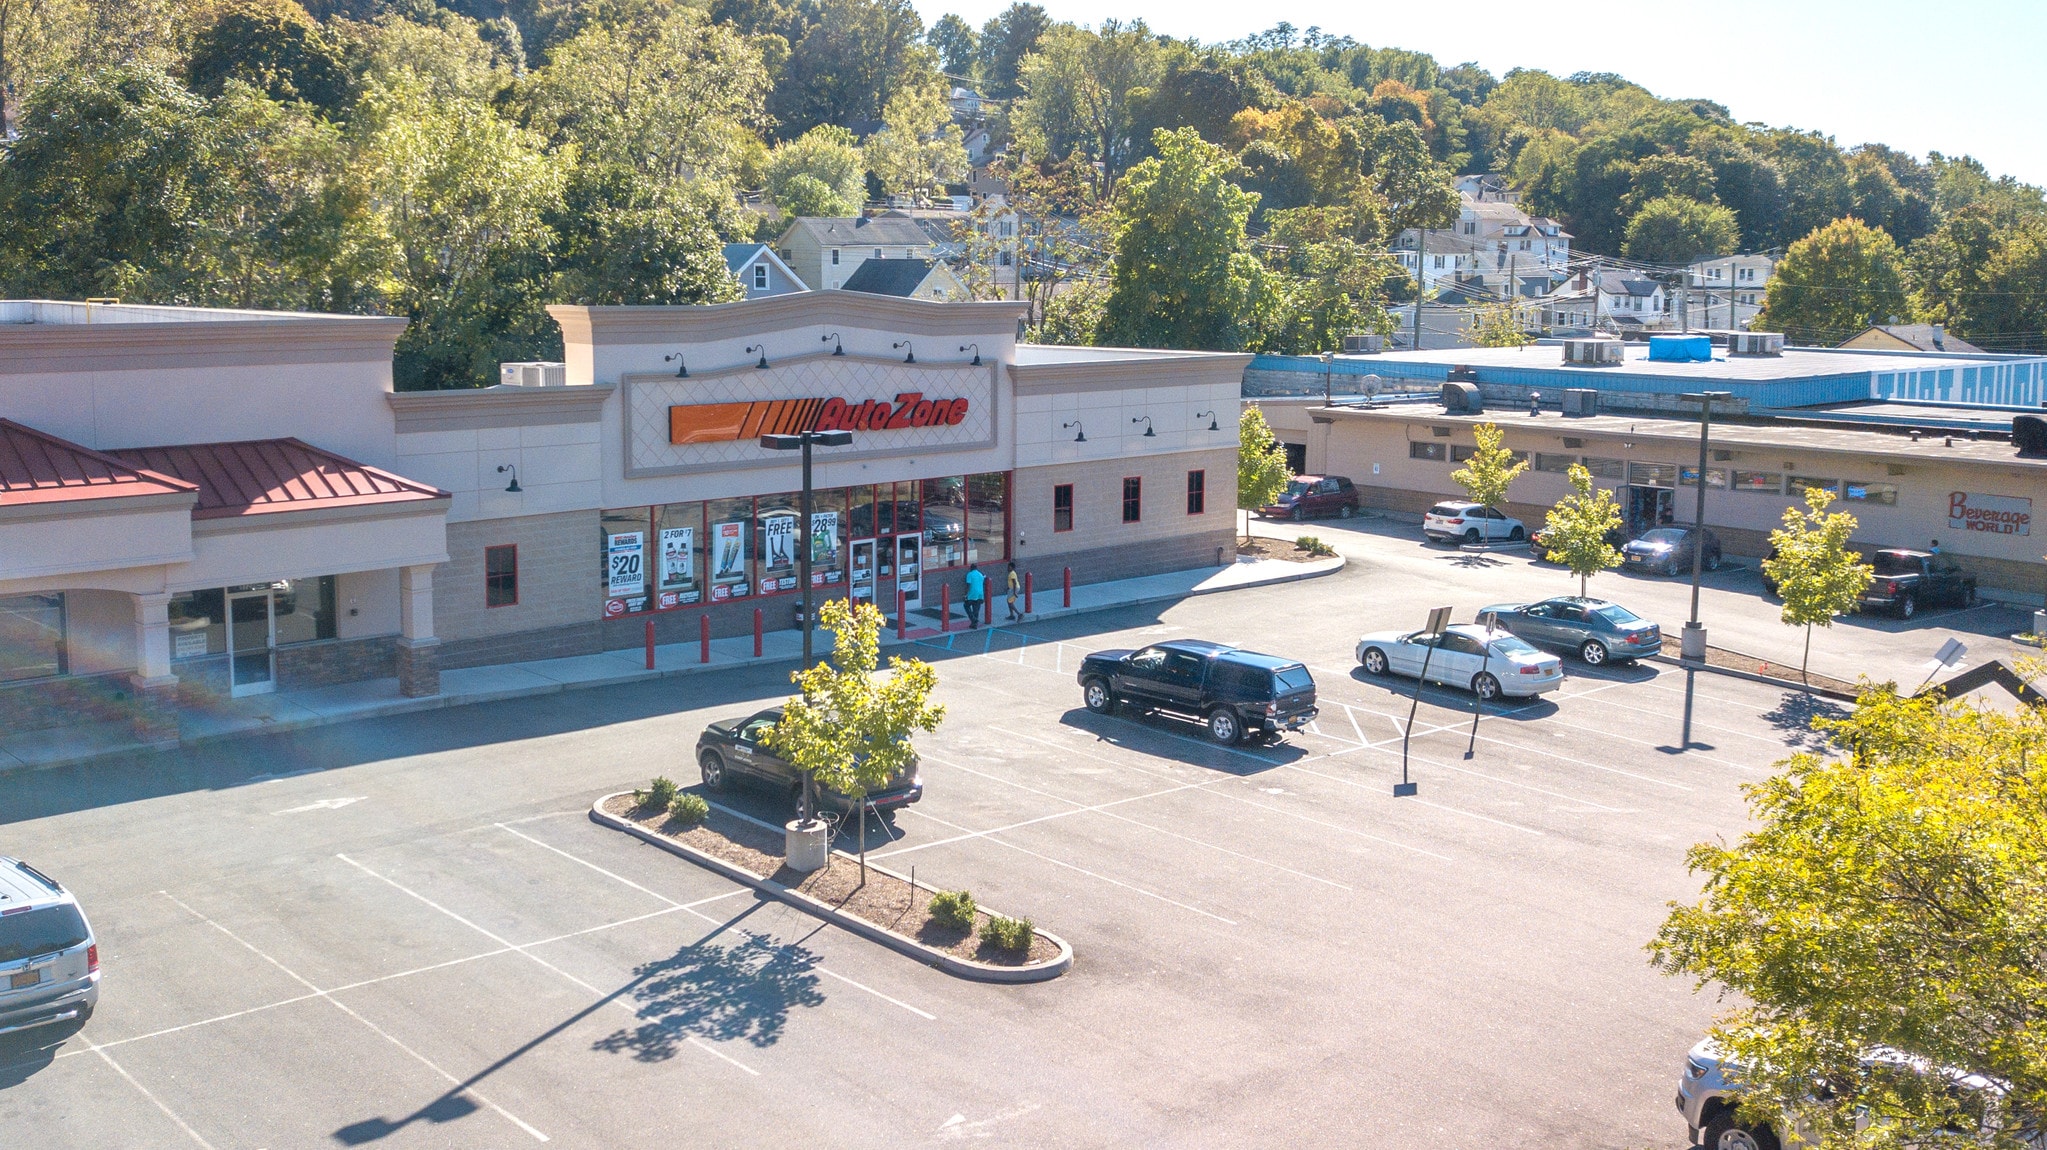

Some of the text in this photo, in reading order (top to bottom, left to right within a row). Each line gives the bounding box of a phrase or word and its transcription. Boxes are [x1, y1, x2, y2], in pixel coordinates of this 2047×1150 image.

[814, 391, 969, 431] AutoZone
[1948, 491, 2029, 532] Beverage
[767, 522, 792, 536] FREE
[1966, 520, 2013, 534] WORLD
[664, 531, 670, 539] 2
[670, 530, 684, 538] FOR
[612, 554, 640, 576] $20
[611, 574, 642, 585] REWARD
[763, 581, 777, 591] FREE
[714, 588, 729, 597] FREE
[662, 595, 676, 604] FREE
